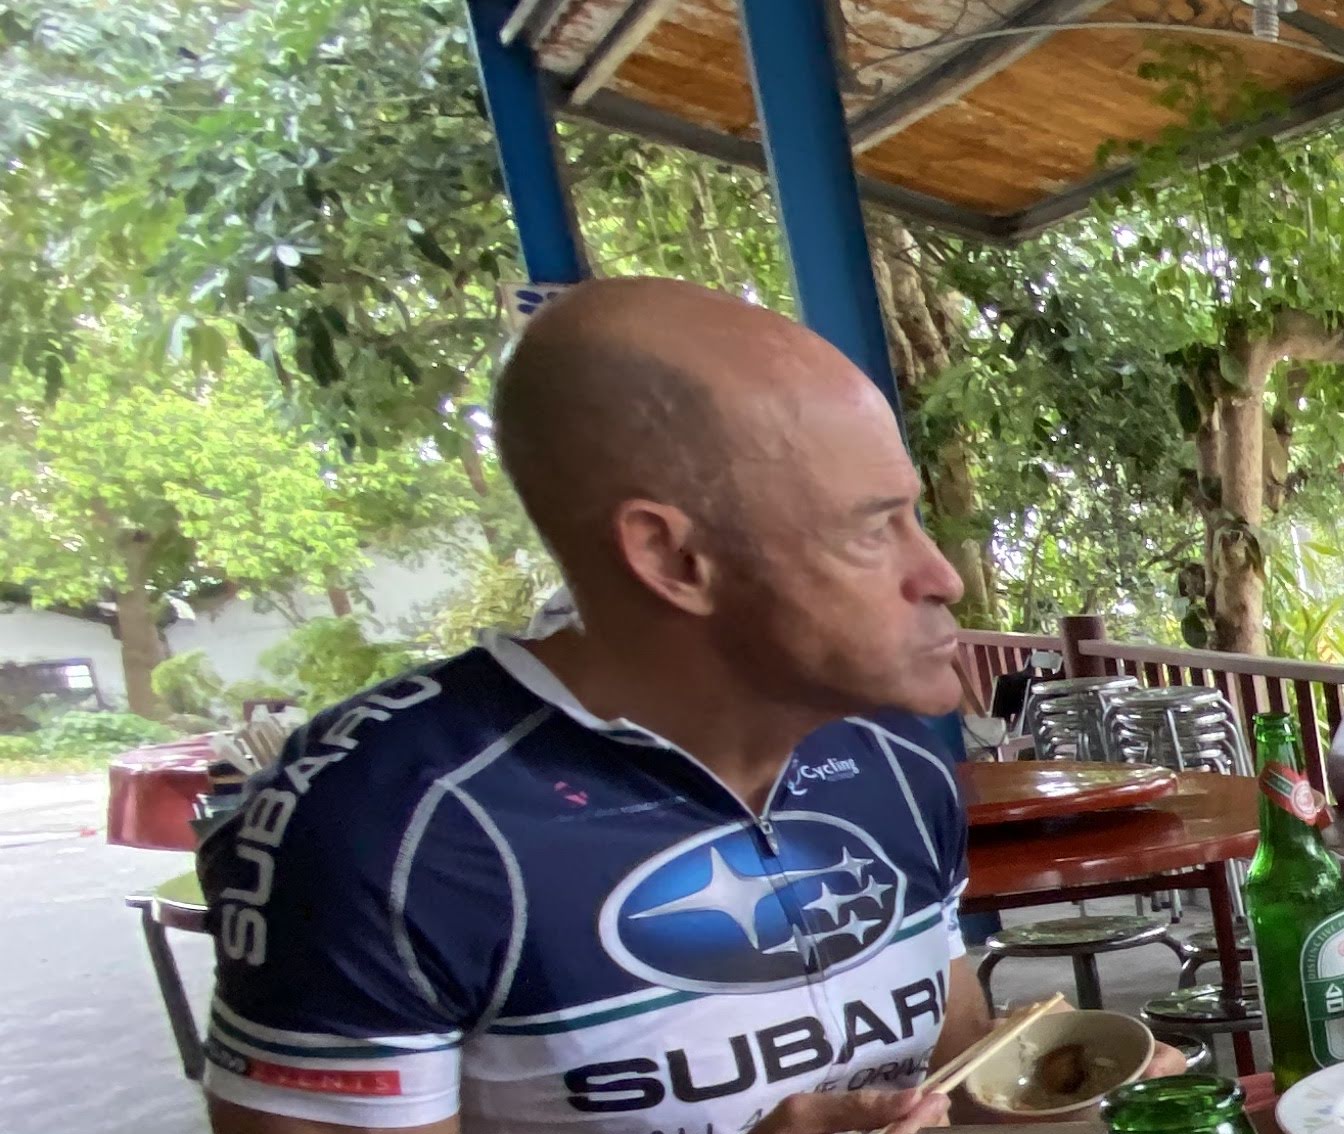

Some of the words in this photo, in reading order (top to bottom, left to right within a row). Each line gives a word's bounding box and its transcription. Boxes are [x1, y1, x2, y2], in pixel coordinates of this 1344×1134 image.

[221, 674, 443, 967] SUBARU
[799, 758, 860, 782] Cycling
[564, 969, 946, 1113] SUBAR
